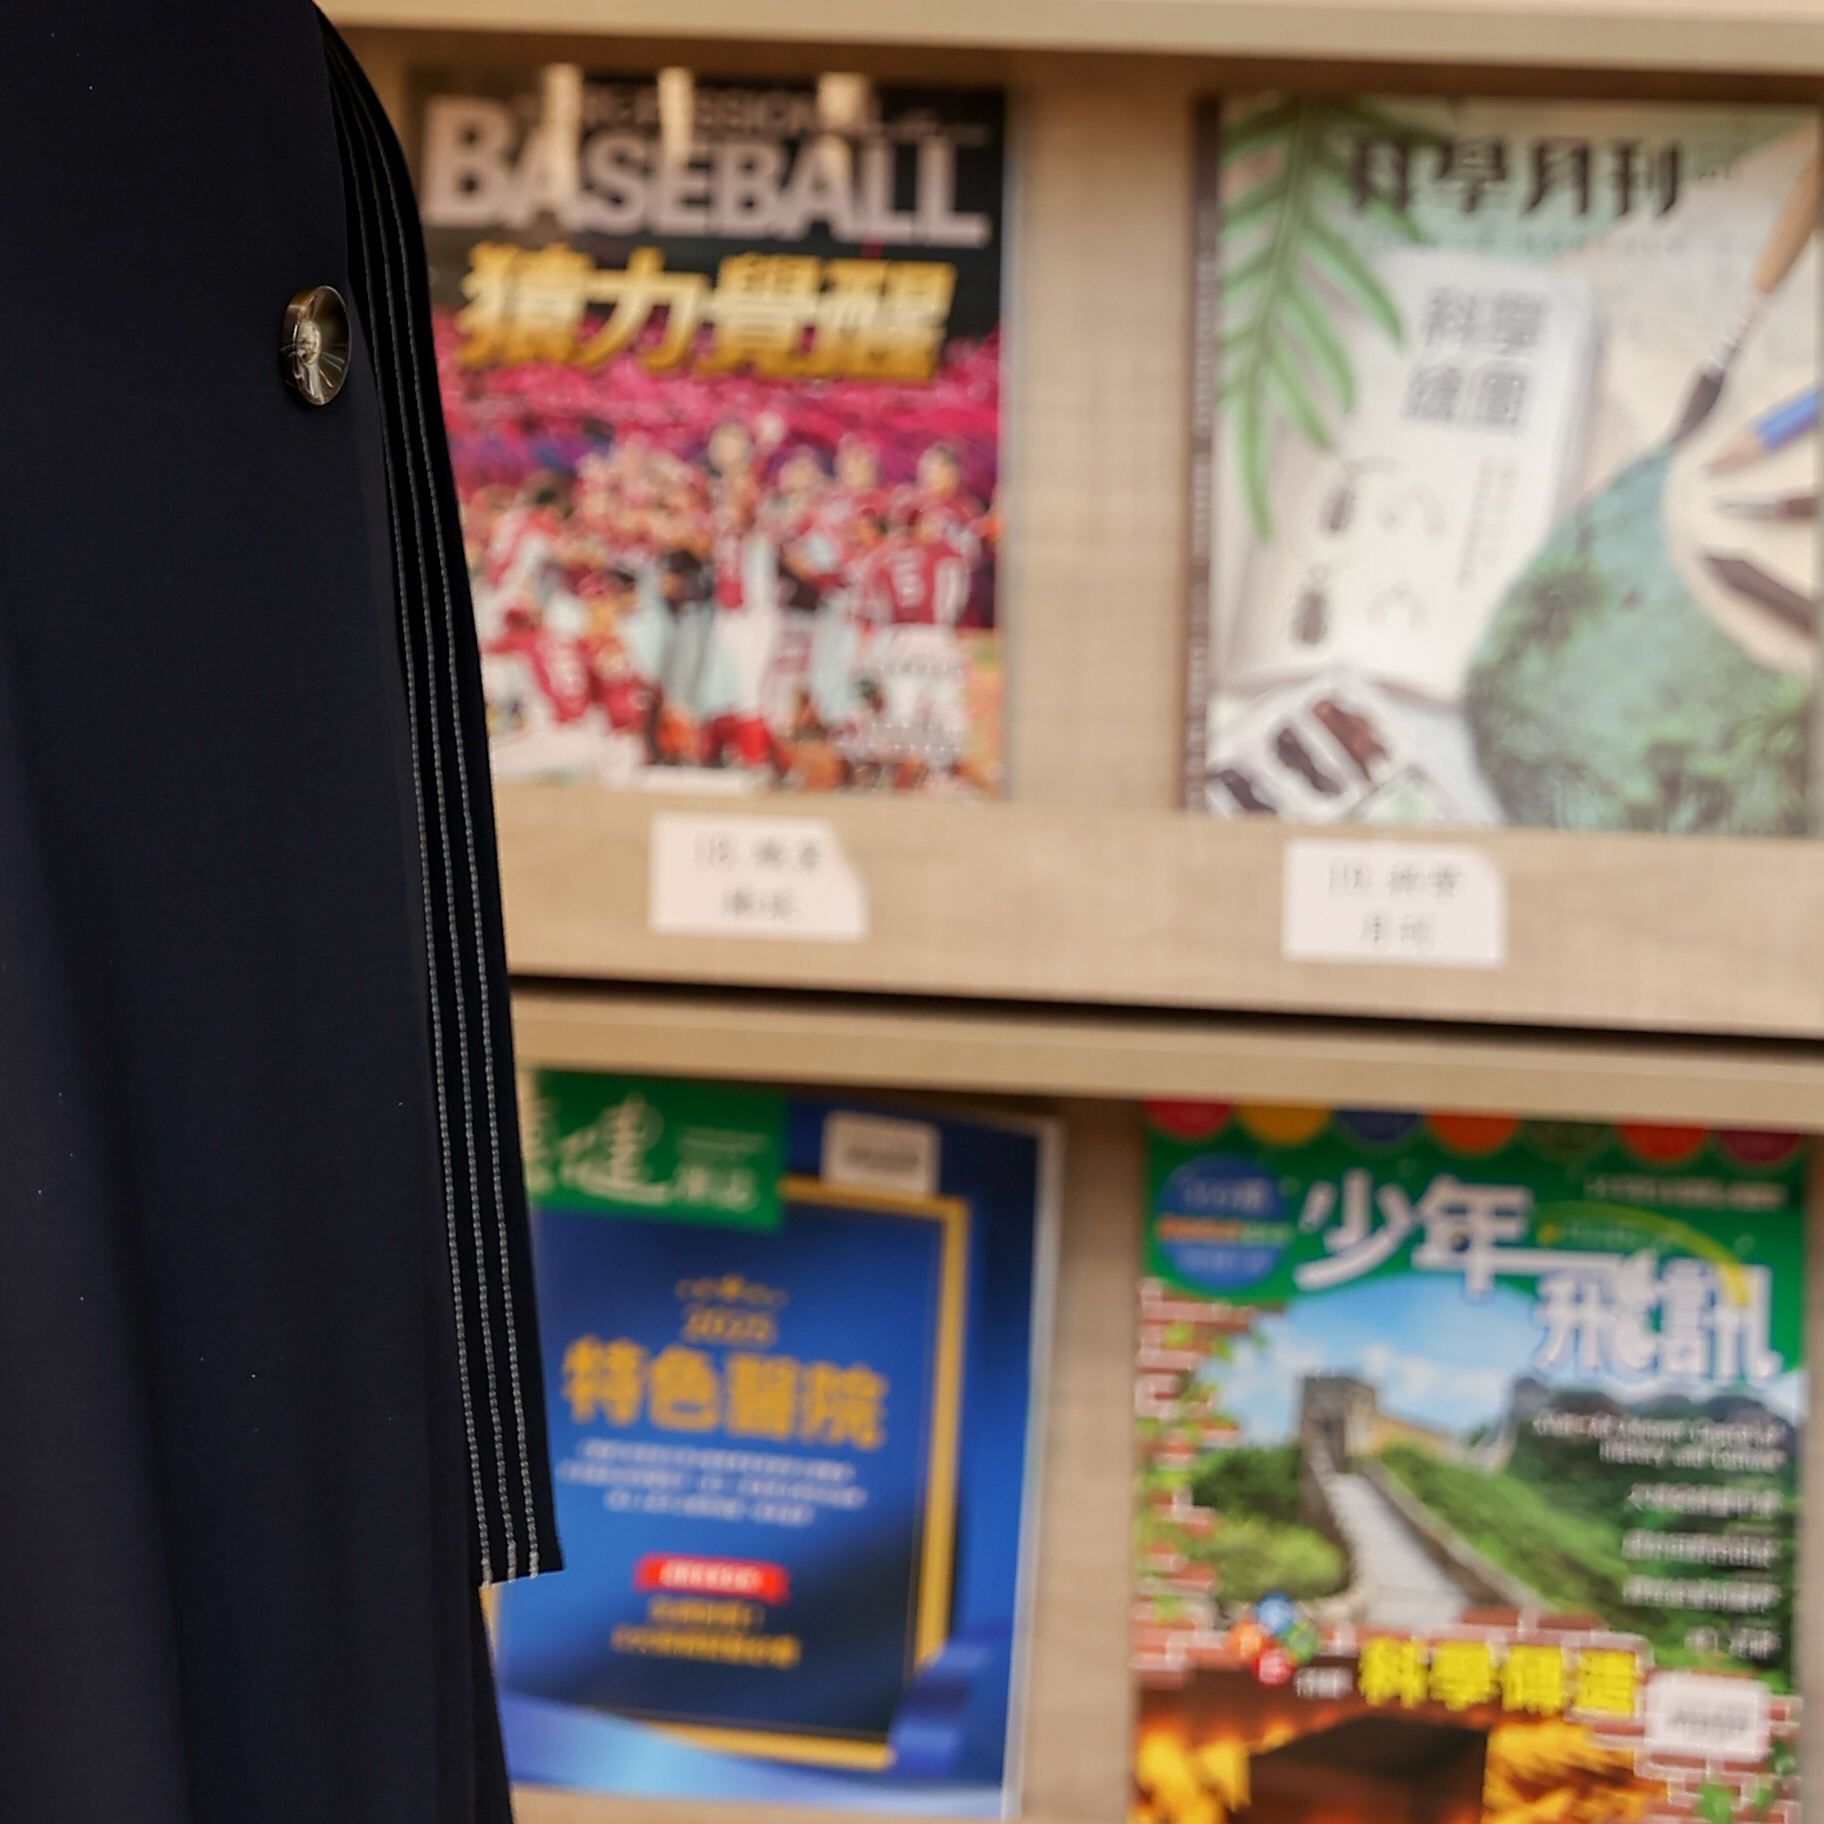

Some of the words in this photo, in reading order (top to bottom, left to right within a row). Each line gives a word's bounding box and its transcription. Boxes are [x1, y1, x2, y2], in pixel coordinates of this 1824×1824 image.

[421, 93, 992, 249] BASEBALL
[457, 240, 959, 382] 猿力覺醒
[1291, 1165, 1536, 1297] 少年
[560, 1334, 890, 1452] 特色醫院
